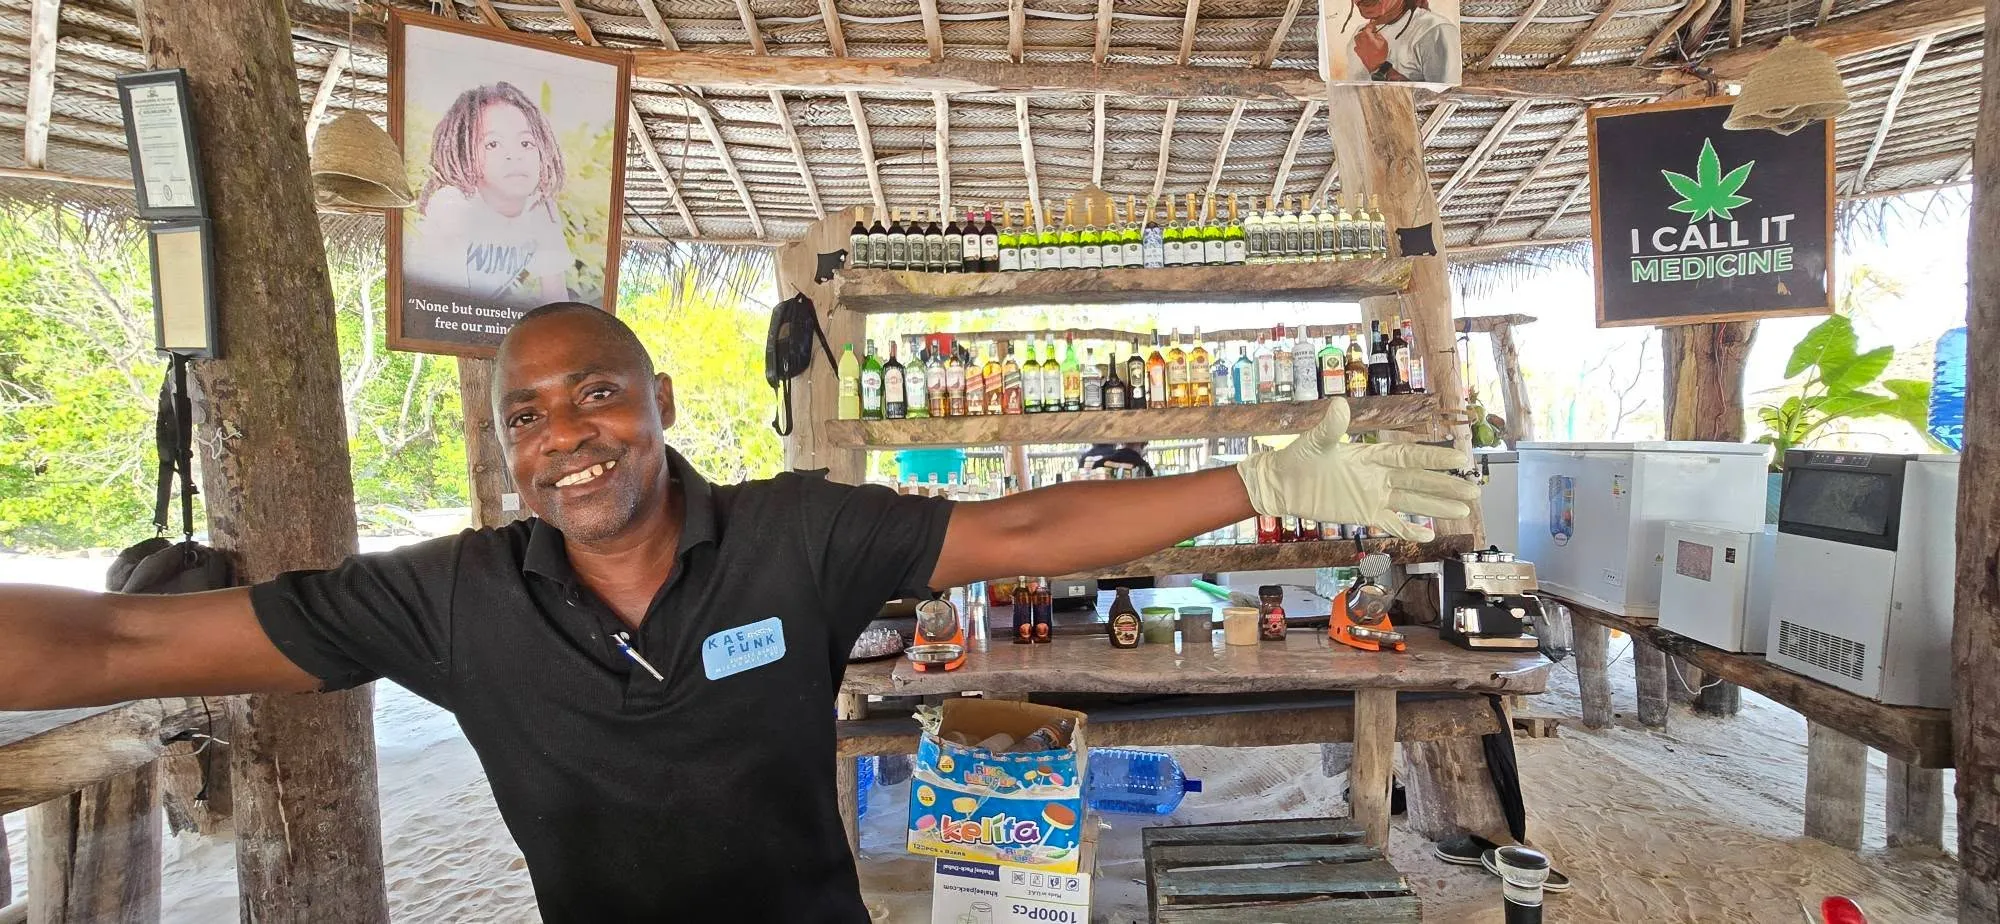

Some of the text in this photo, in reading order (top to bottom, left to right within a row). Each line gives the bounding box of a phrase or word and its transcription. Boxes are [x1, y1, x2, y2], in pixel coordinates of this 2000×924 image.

[1631, 214, 1795, 253] I CALL IT
[1631, 247, 1794, 283] MEDICINE
[452, 302, 473, 315] but
[435, 317, 458, 330] free
[461, 322, 483, 332] our
[727, 634, 776, 656] FUNK
[1012, 904, 1077, 924] 1000Pcs
